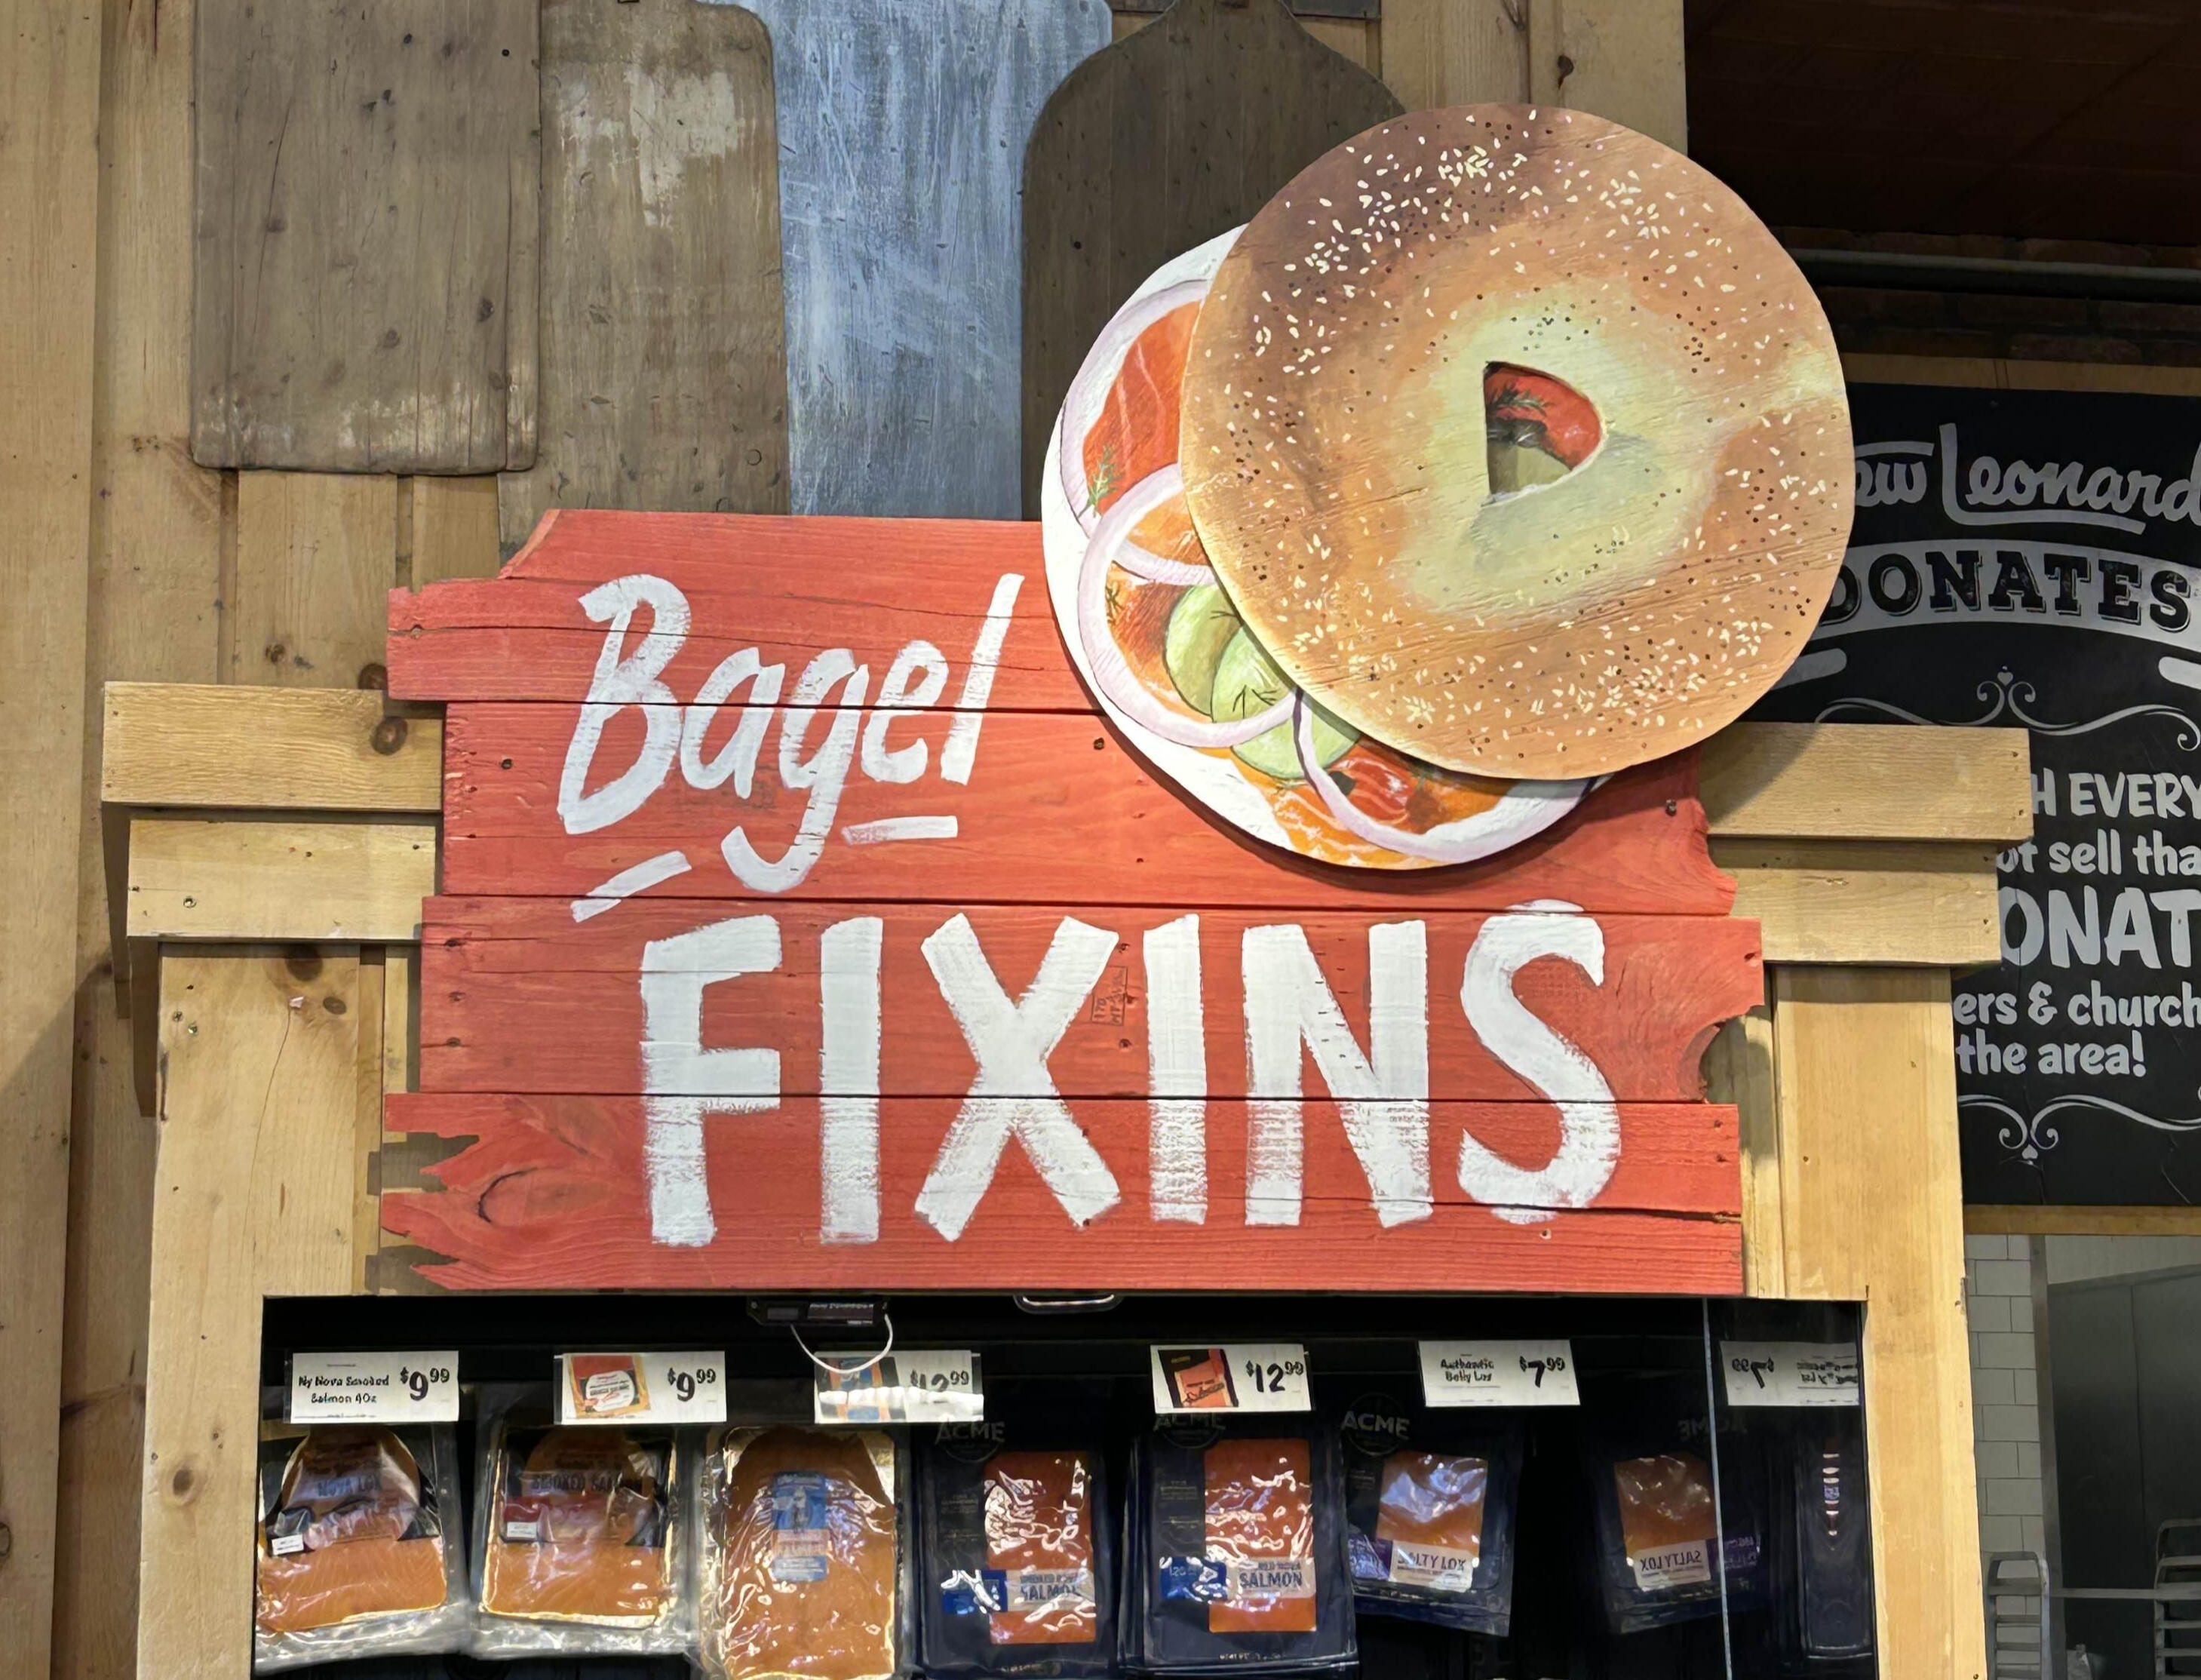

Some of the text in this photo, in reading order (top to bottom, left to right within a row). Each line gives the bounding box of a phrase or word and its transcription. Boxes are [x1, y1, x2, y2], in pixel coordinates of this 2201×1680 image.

[1819, 548, 2192, 633] DONATES
[557, 573, 1025, 893] Bagel
[2068, 771, 2201, 820] EVERY
[2049, 828, 2122, 875] sell
[2132, 830, 2201, 876] tha
[1953, 993, 2018, 1025] ers
[2028, 981, 2058, 1025] &
[641, 899, 1621, 1247] FIXINS
[1955, 1027, 2147, 1078] the area!
[1341, 1410, 1410, 1440] ACME
[1239, 1572, 1302, 1588] SALMON
